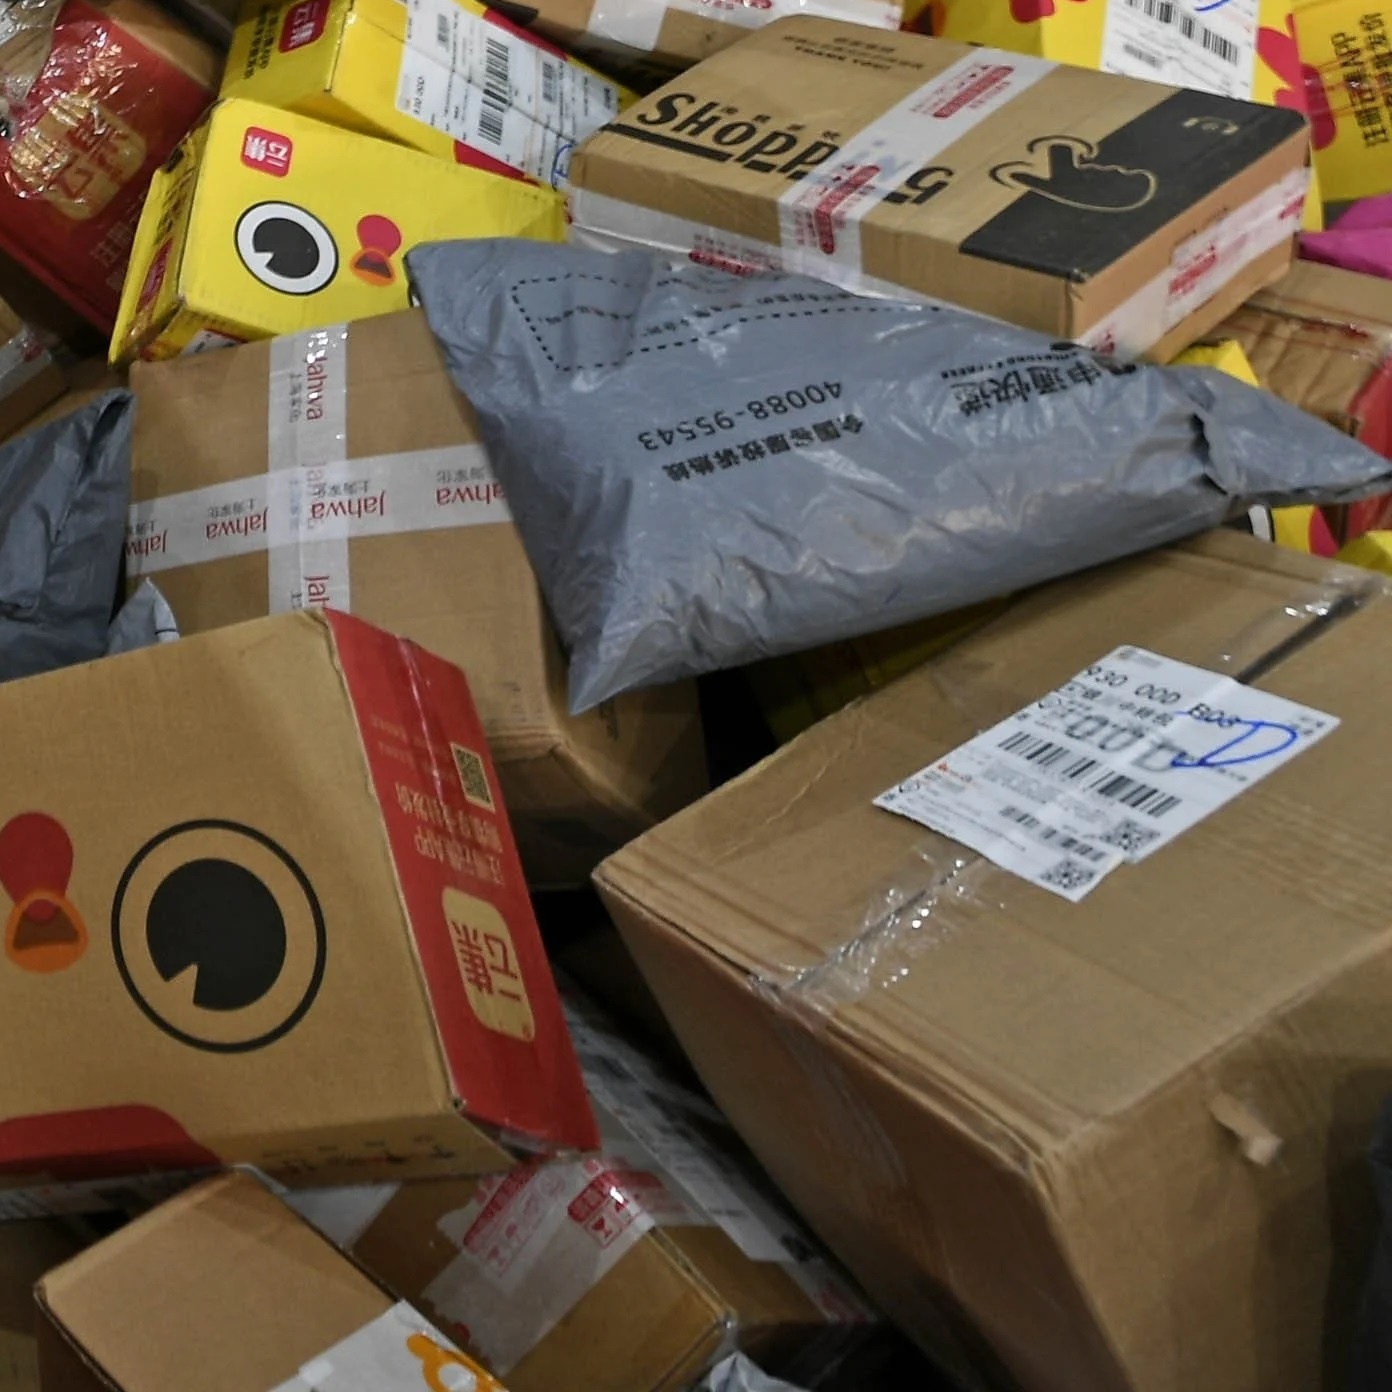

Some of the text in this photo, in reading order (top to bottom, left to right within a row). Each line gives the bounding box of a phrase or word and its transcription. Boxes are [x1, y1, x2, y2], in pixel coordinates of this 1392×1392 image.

[634, 90, 954, 208] SHOPPG
[954, 357, 1119, 421] 申通快递
[635, 376, 845, 453] 40088-95543
[309, 489, 387, 522] Jahwa
[435, 481, 506, 508] ahwa
[205, 506, 269, 541] Jahwa
[1086, 664, 1130, 690] 930
[451, 917, 523, 1003] 云集
